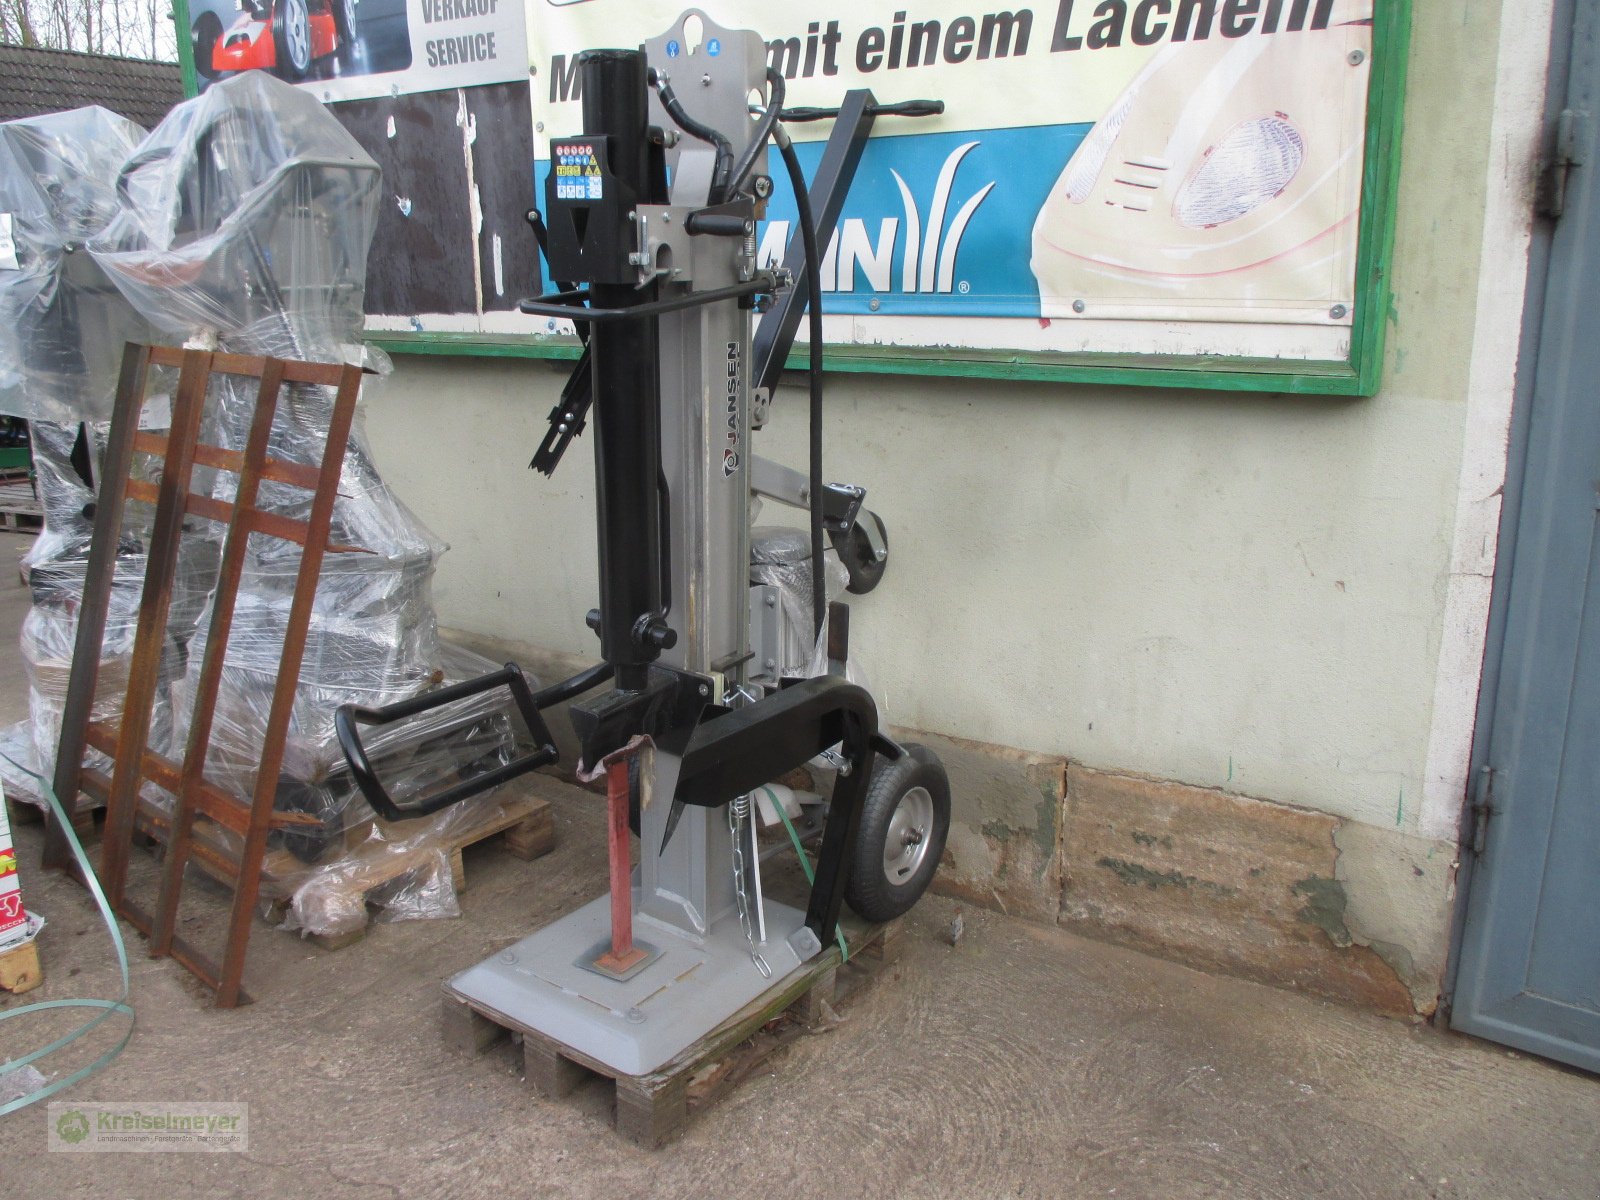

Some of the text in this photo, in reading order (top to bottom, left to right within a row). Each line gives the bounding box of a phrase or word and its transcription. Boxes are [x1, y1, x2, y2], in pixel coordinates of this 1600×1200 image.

[421, 0, 498, 24] VERKAUF
[426, 32, 497, 68] SERVICE
[765, 20, 842, 80] mit
[855, 8, 1034, 74] einem
[727, 342, 738, 445] JANSEN
